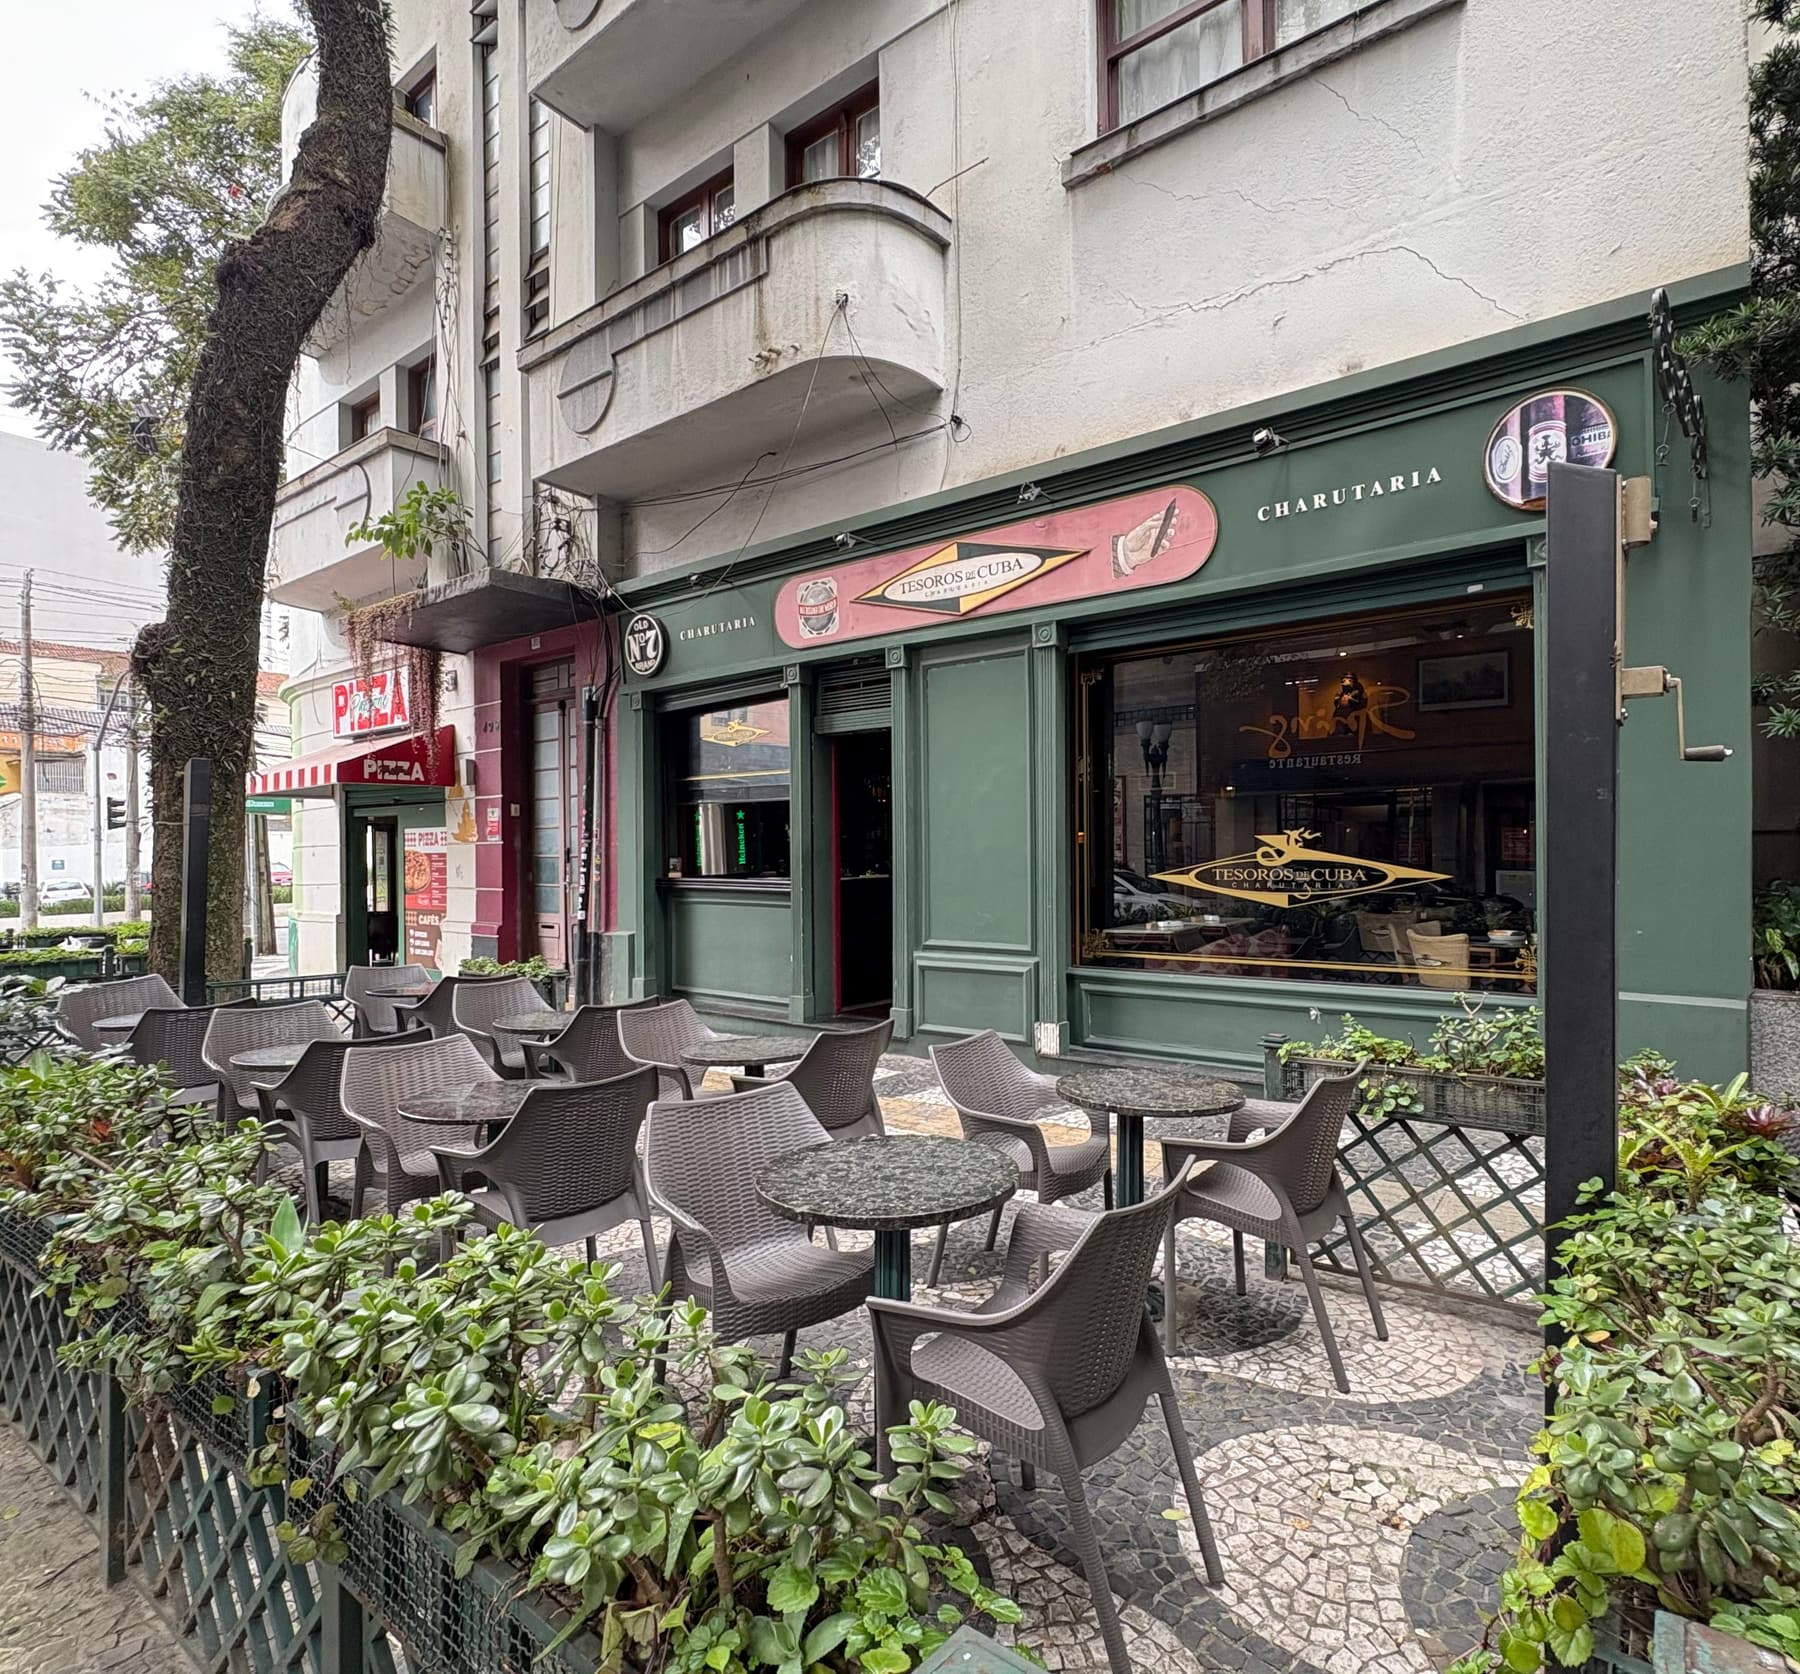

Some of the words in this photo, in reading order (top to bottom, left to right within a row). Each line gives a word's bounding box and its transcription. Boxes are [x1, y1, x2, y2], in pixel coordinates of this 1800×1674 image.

[1257, 467, 1442, 521] CHARUTARIA
[899, 570, 963, 594] TESOROS
[977, 558, 1024, 578] CUBA
[633, 620, 649, 631] OLD
[680, 616, 756, 641] CHARUTARIA
[635, 659, 656, 671] BRAND
[334, 669, 408, 735] PIZZA
[363, 759, 425, 781] PIZZA
[418, 831, 440, 847] PIZZA
[737, 822, 746, 864] Heineken
[1212, 868, 1294, 881] TESOROS
[1311, 868, 1368, 881] CUBA
